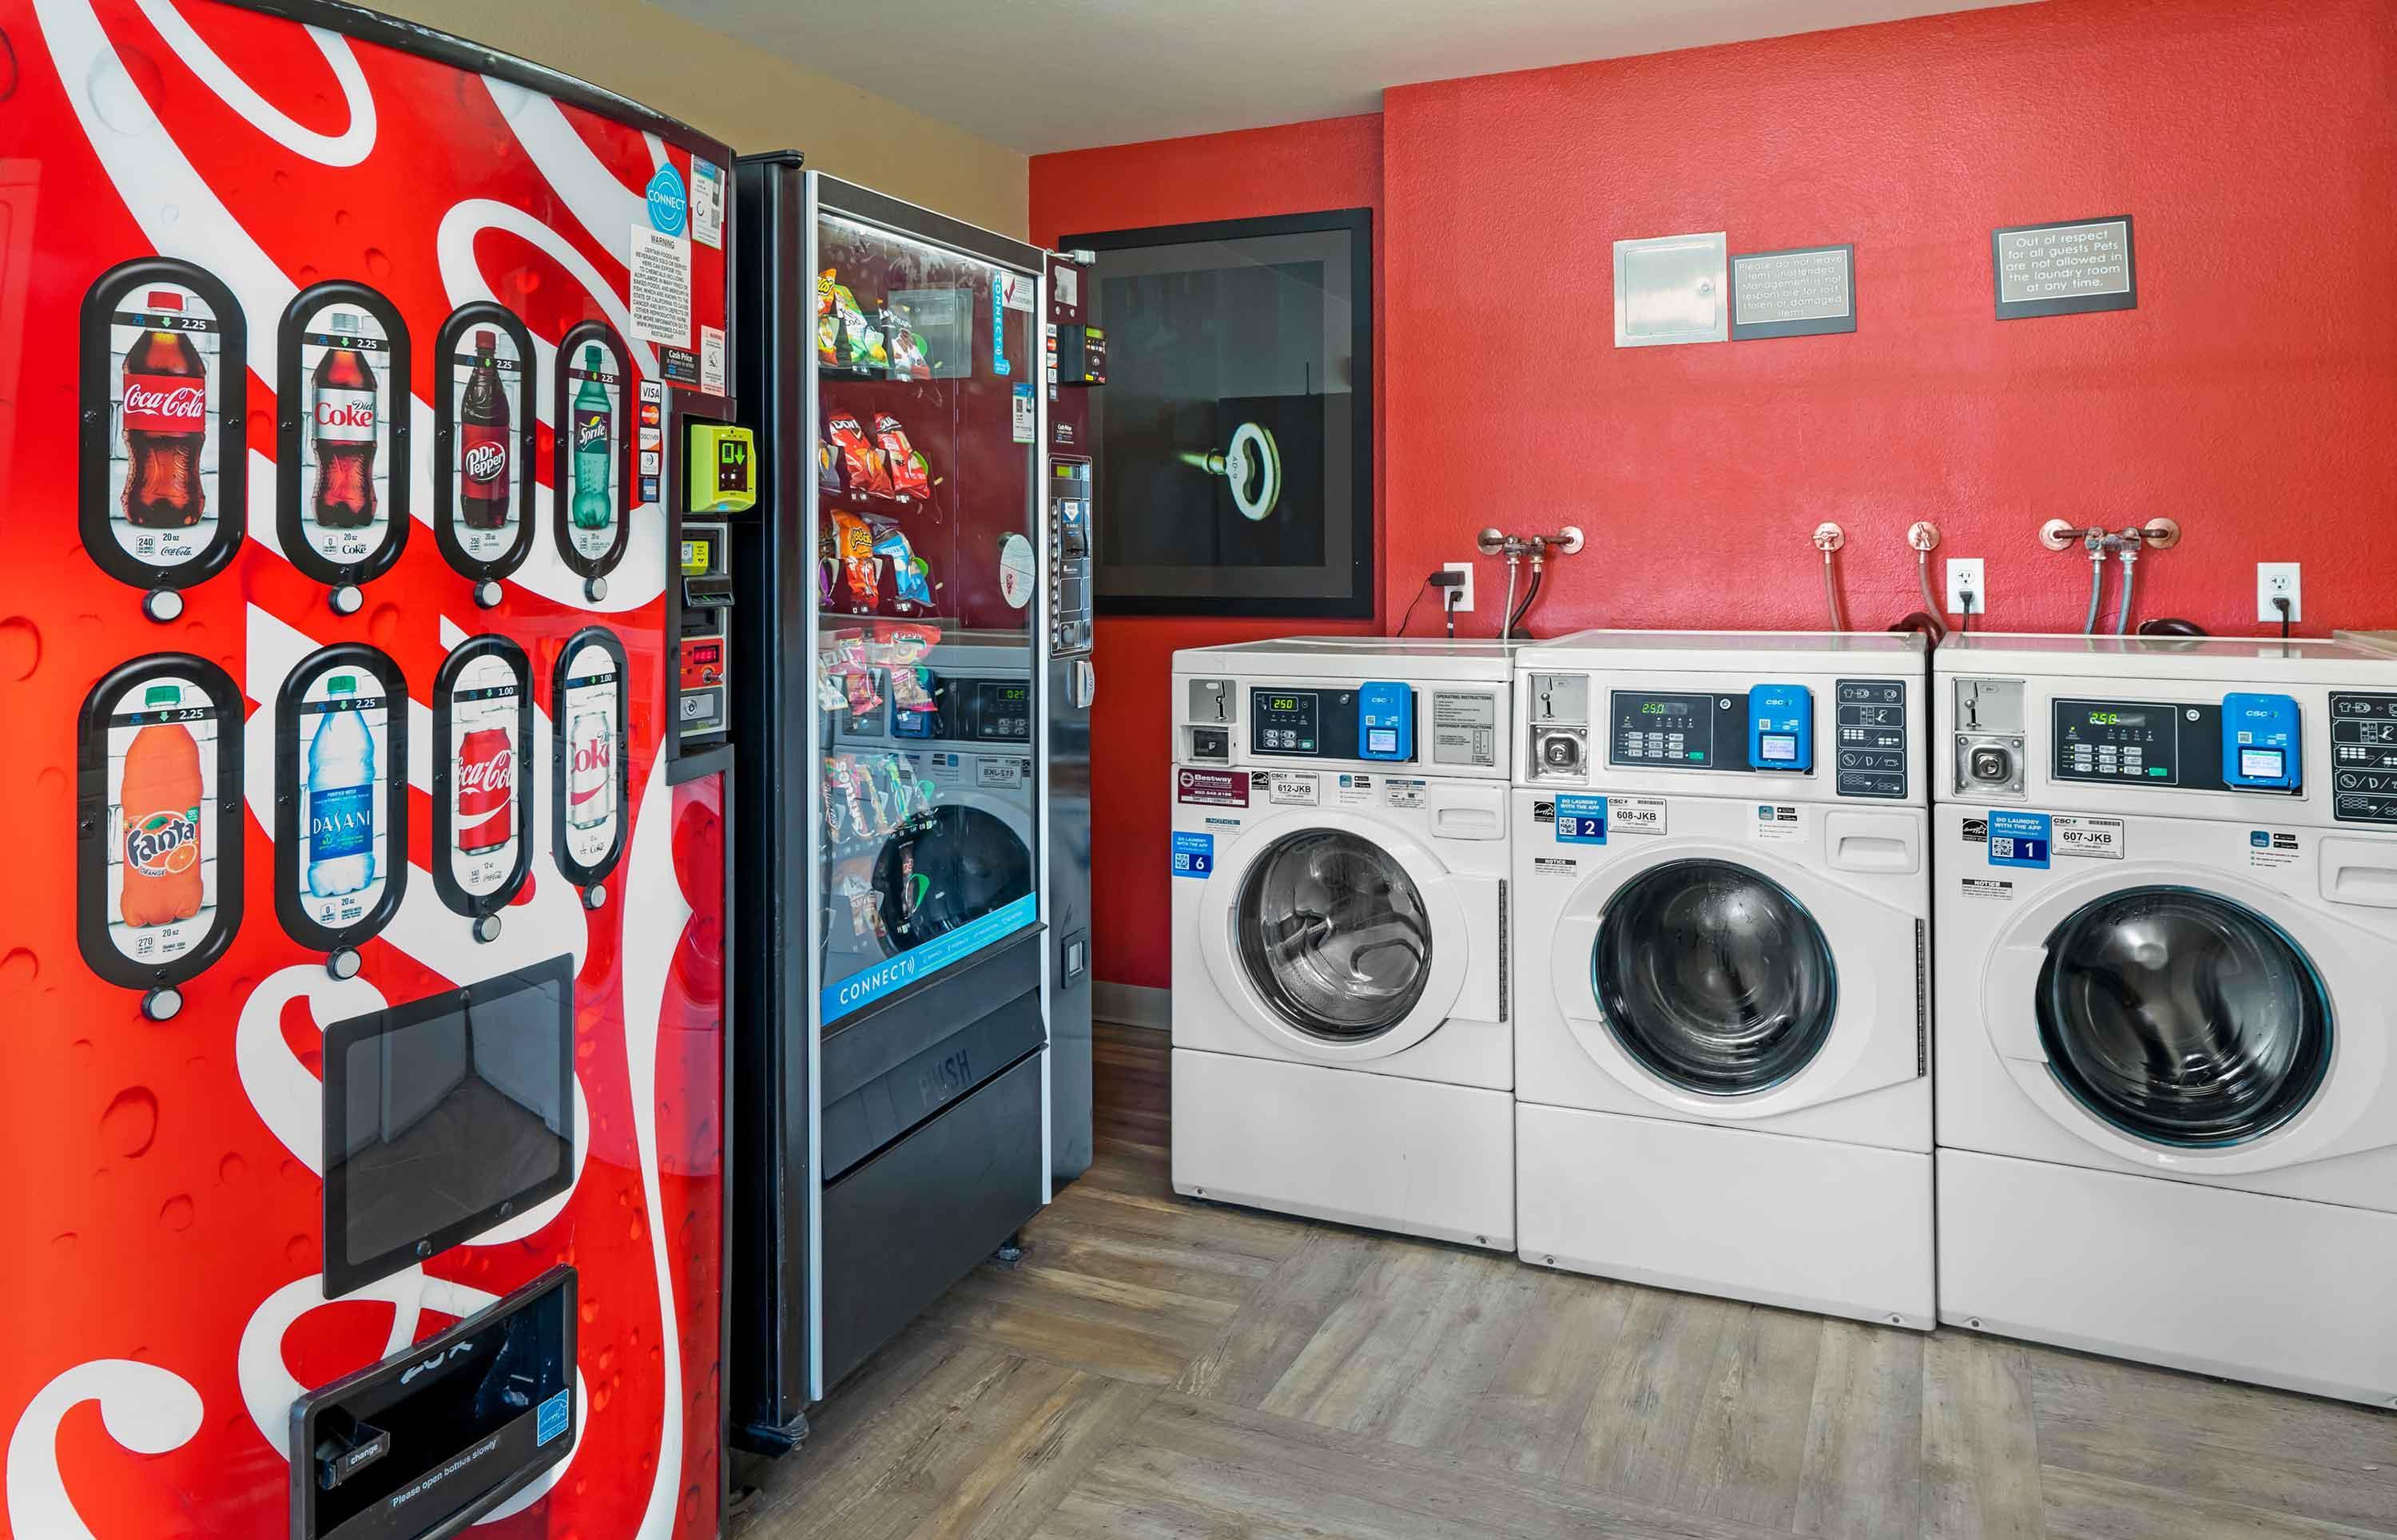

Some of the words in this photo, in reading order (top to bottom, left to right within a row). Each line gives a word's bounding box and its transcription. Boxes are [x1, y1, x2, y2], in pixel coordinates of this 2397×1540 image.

[648, 189, 686, 211] CONNECT
[651, 235, 674, 249] WARNING
[2017, 235, 2038, 248] Out
[2045, 235, 2055, 244] of
[2061, 230, 2108, 243] respect
[2008, 251, 2024, 260] for
[2029, 248, 2044, 257] all
[2049, 244, 2089, 257] guests
[2093, 242, 2118, 251] Pets
[1739, 262, 1771, 271] Please
[1794, 258, 1809, 267] not
[1814, 255, 1842, 264] leave
[2006, 263, 2026, 272] are
[2031, 260, 2050, 268] not
[2057, 254, 2106, 267] allowed
[2009, 272, 2029, 281] the
[2034, 268, 2082, 280] laundry
[2088, 265, 2121, 275] room
[2026, 284, 2039, 292] at
[2045, 281, 2066, 291] any
[2073, 278, 2103, 288] time.
[1790, 295, 1842, 307] damaged
[182, 320, 206, 331] 2.25
[357, 339, 377, 349] 2.25
[669, 350, 680, 359] Cash
[681, 353, 693, 363] Price
[497, 360, 511, 369] 2.25
[642, 388, 659, 399] VISA
[123, 383, 205, 419] Coca-Cola
[352, 399, 373, 411] Diet
[315, 402, 373, 428] Coke
[581, 426, 606, 443] Sprite
[479, 447, 495, 462] Dr
[468, 449, 503, 476] Pepper
[161, 546, 192, 556] Coca-Cola
[342, 545, 366, 554] Coke
[499, 687, 513, 697] 1.00
[356, 700, 376, 708] 2.25
[179, 709, 203, 719] 2.25
[1195, 774, 1232, 783] Bestway
[313, 810, 370, 835] DASANI
[1617, 812, 1656, 820] 608-JKB
[1585, 821, 1595, 834] 2
[128, 820, 195, 867] Fanta
[2063, 832, 2111, 843] 607-JKB
[2026, 843, 2033, 857] 1
[1195, 857, 1205, 869] 6
[138, 937, 153, 947] 270
[841, 963, 906, 1003] CONNECT
[351, 1443, 378, 1465] change
[393, 1486, 420, 1506] Please
[422, 1472, 443, 1489] open
[473, 1439, 497, 1459] slowly
